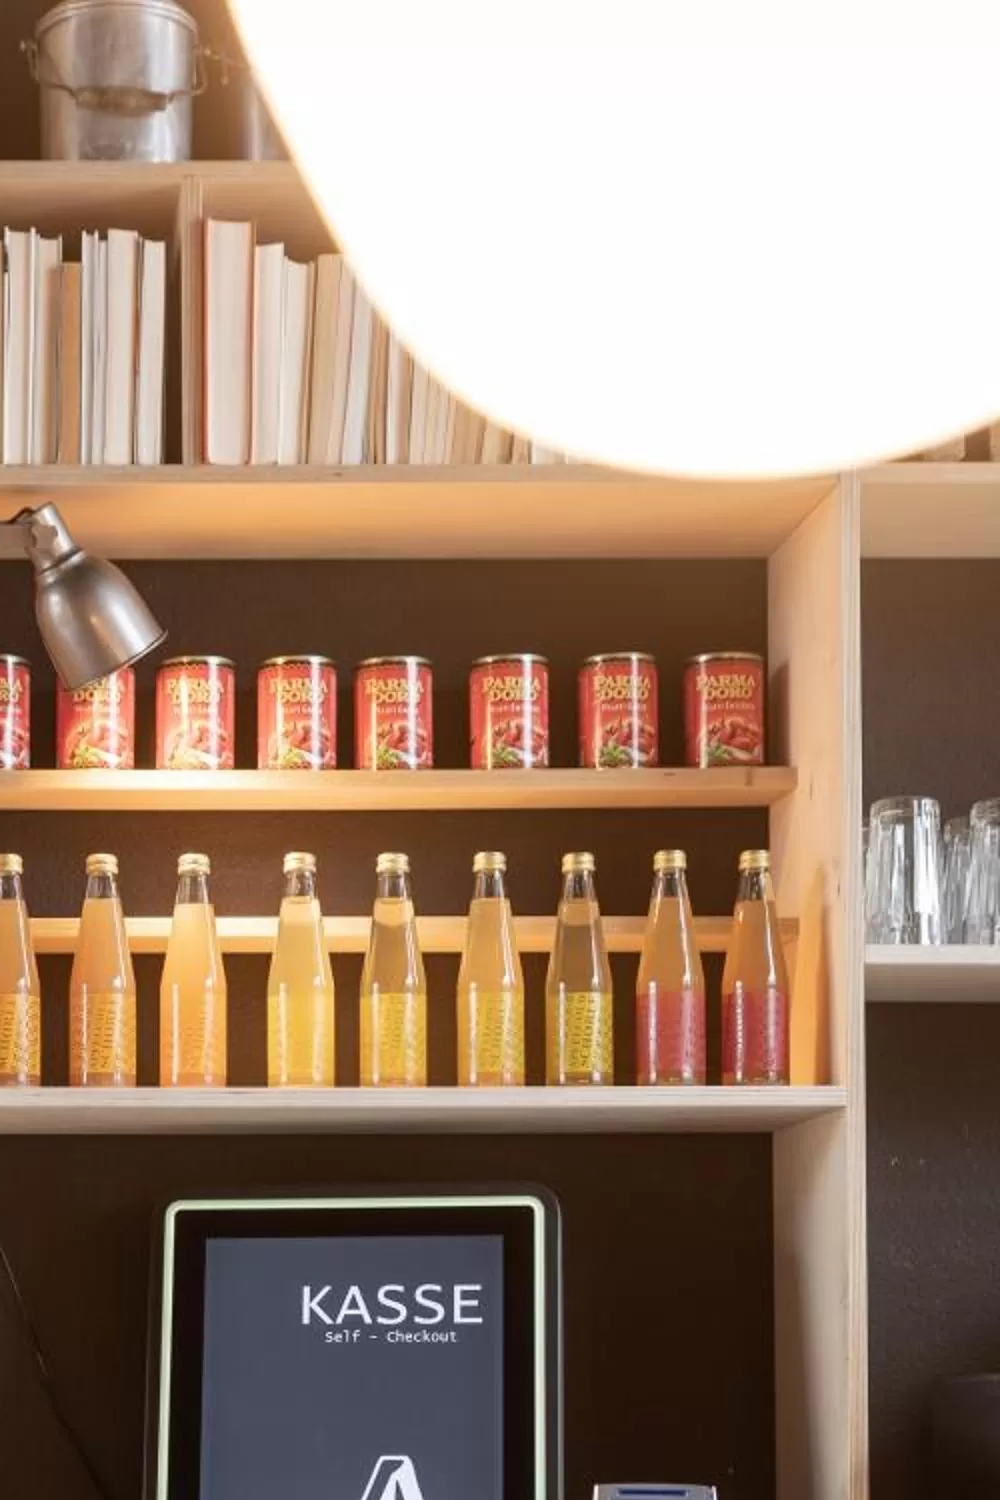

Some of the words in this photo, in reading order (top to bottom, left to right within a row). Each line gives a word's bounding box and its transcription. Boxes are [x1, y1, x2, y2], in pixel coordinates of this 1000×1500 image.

[696, 674, 756, 690] PARMA
[703, 687, 752, 700] DORO
[301, 1283, 484, 1325] KASSE
[323, 1329, 361, 1344] Self
[386, 1328, 457, 1345] Checkout
